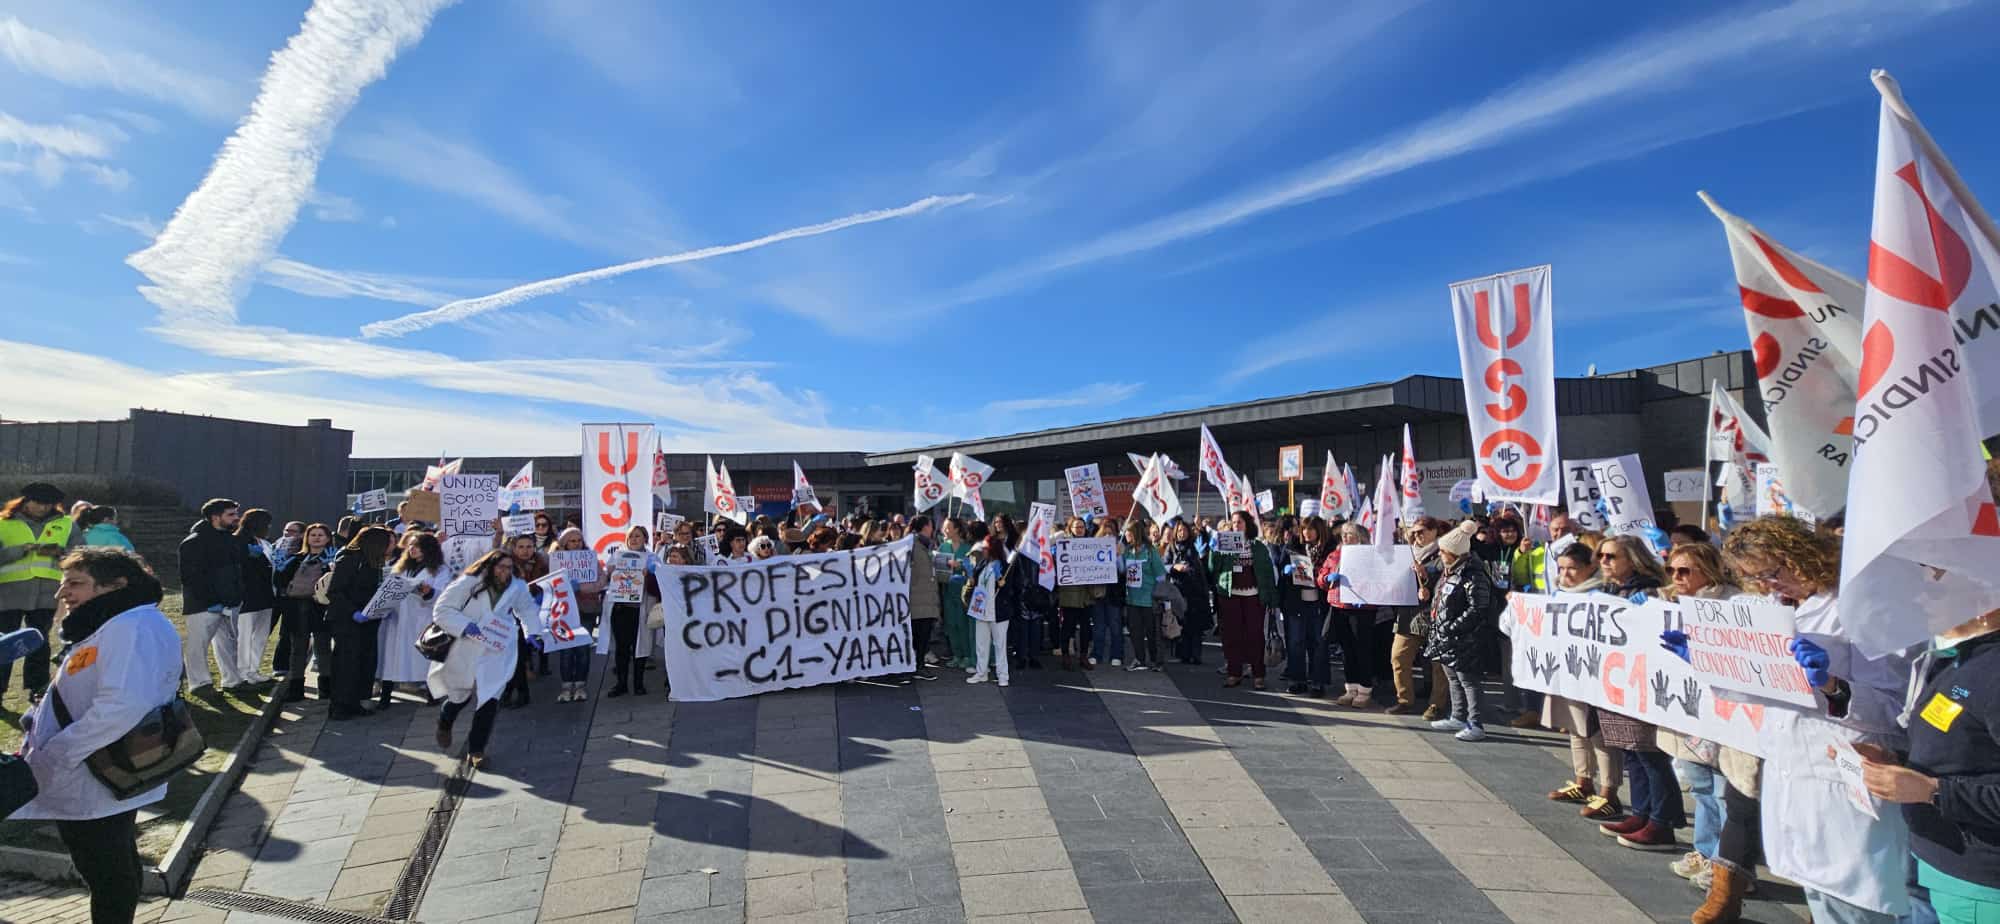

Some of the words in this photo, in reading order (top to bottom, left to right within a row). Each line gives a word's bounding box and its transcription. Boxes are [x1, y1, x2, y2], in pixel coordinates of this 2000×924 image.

[1474, 282, 1543, 492] USO
[443, 492, 496, 506] SOMOS
[1096, 550, 1113, 563] C1
[1545, 602, 1628, 647] TCAES
[1694, 599, 1729, 624] POR
[1732, 603, 1753, 627] UN
[682, 618, 748, 650] CON
[1602, 651, 1648, 714] C1
[1749, 659, 1765, 687] Y
